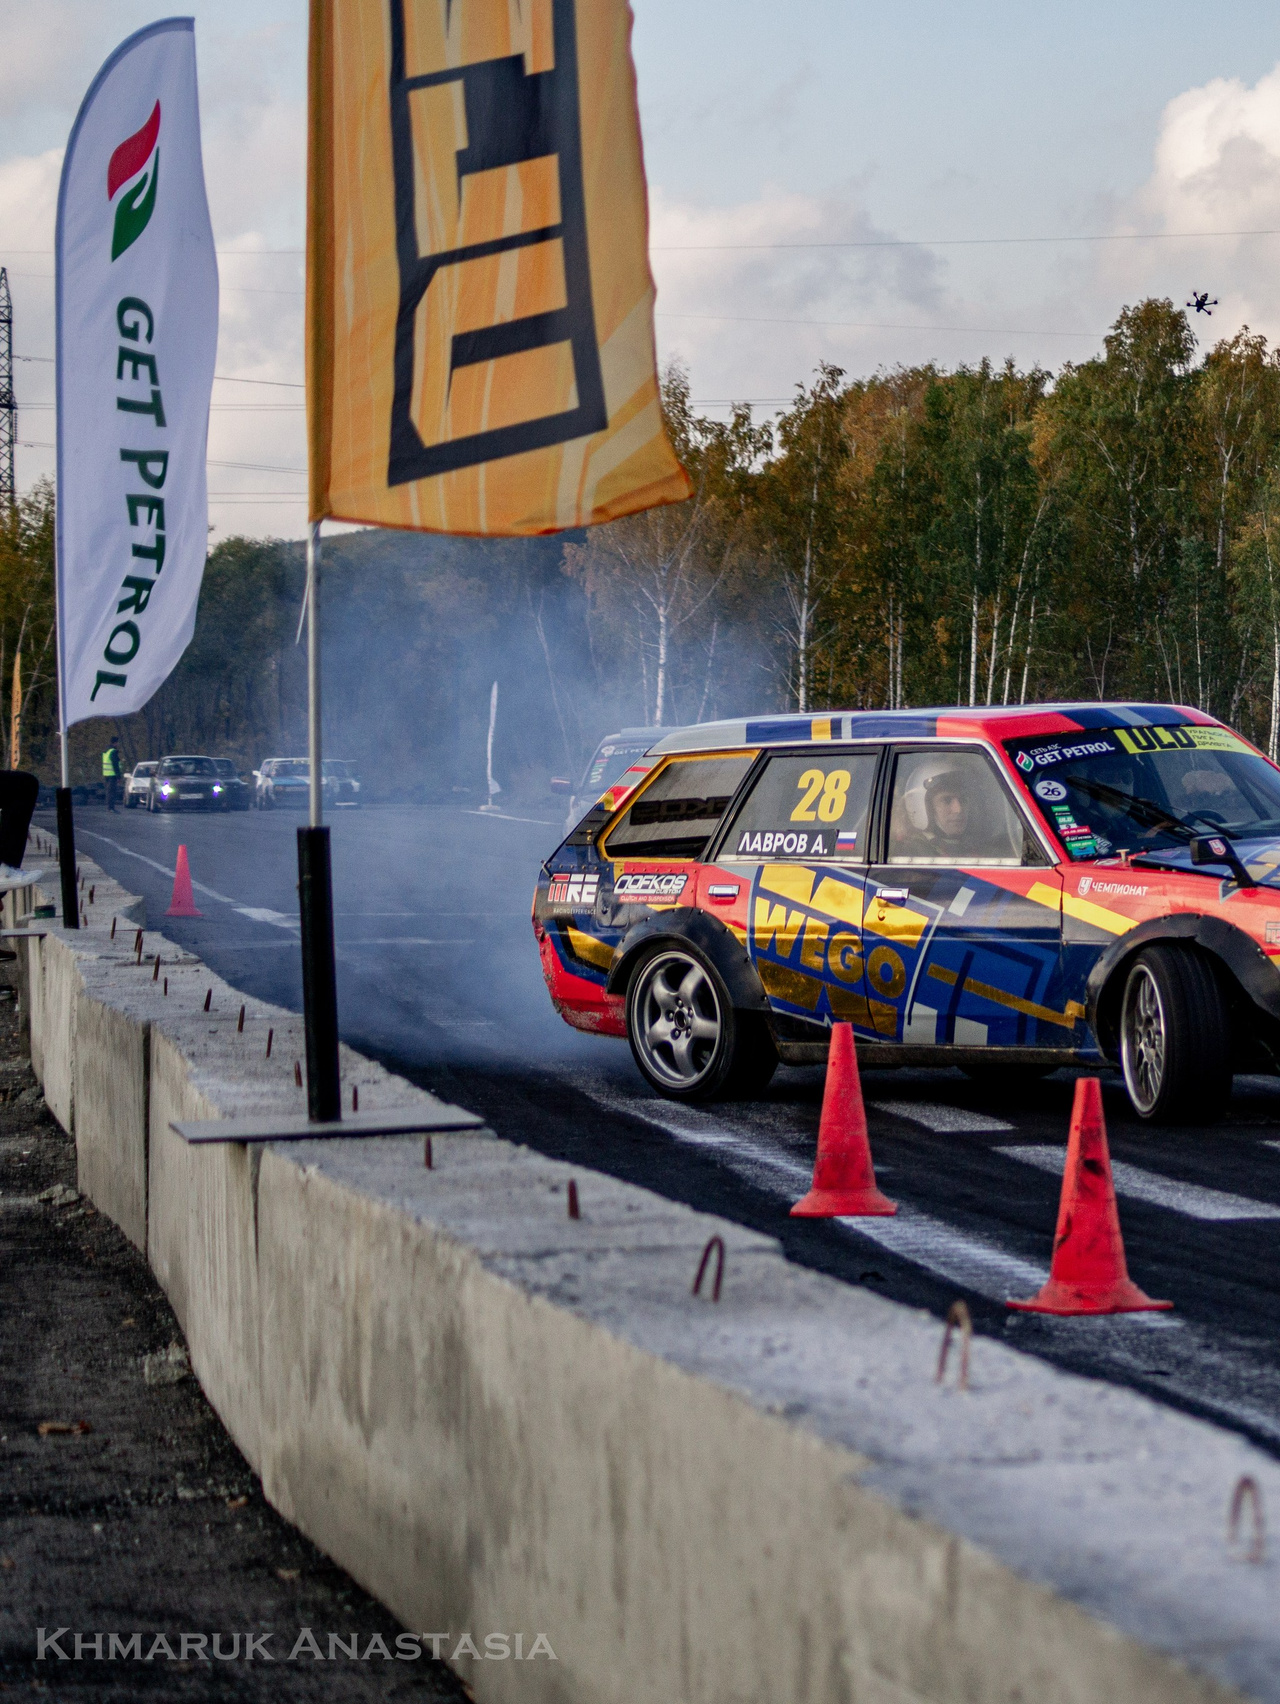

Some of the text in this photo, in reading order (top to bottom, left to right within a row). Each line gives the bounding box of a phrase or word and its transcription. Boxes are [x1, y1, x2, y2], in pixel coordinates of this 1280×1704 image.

[90, 296, 170, 702] GET PETROL
[1030, 747, 1048, 756] СЕТЬ
[1035, 741, 1115, 765] GET PETROL
[790, 769, 851, 822] 28
[1042, 787, 1061, 796] 26
[738, 832, 828, 854] ЛАВРОВ А.
[1092, 881, 1148, 897] ЧЕМПИОНАТ
[754, 896, 906, 998] WEGO
